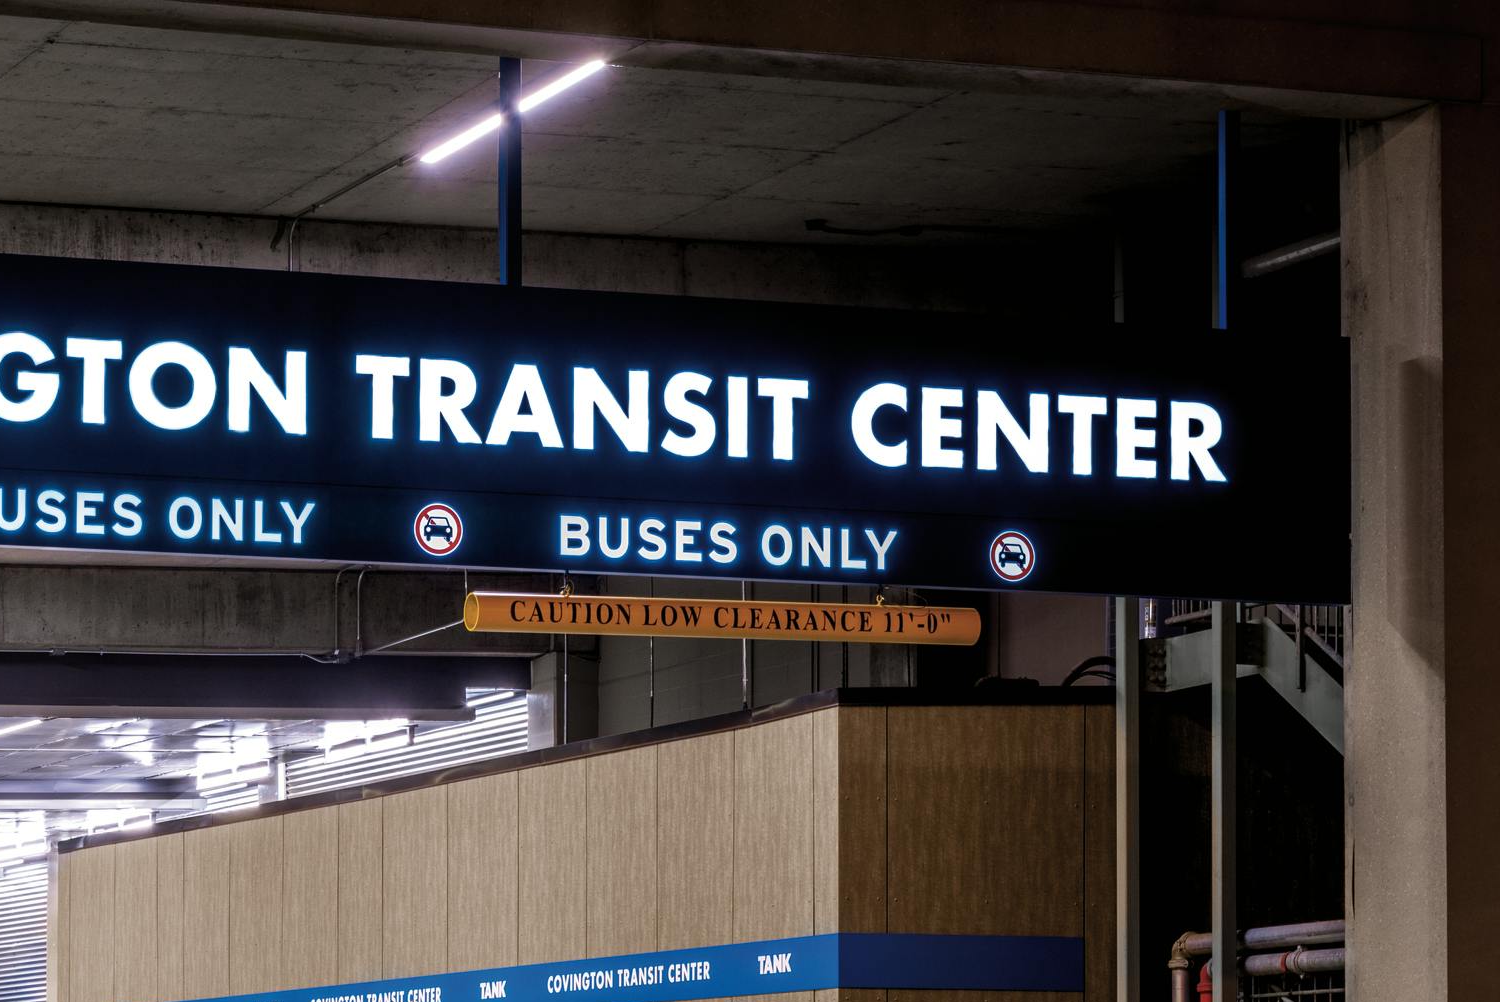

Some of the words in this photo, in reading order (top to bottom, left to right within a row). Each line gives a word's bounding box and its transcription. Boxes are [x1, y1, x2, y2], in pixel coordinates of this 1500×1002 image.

[355, 354, 809, 461] TRANSIT
[851, 383, 1228, 482] CENTER
[169, 496, 316, 544] ONLY
[559, 514, 738, 564] BUSES
[761, 523, 899, 570] ONLY
[510, 600, 631, 625] CAUTION
[643, 604, 702, 627] LOW
[714, 607, 873, 633] CLEARANCE
[884, 611, 951, 634] 11'-0"
[547, 970, 613, 994] COVINGTON
[618, 964, 663, 988] TRANSIT
[668, 961, 710, 983] CENTER
[758, 953, 792, 975] TANK
[480, 980, 506, 999] TANK
